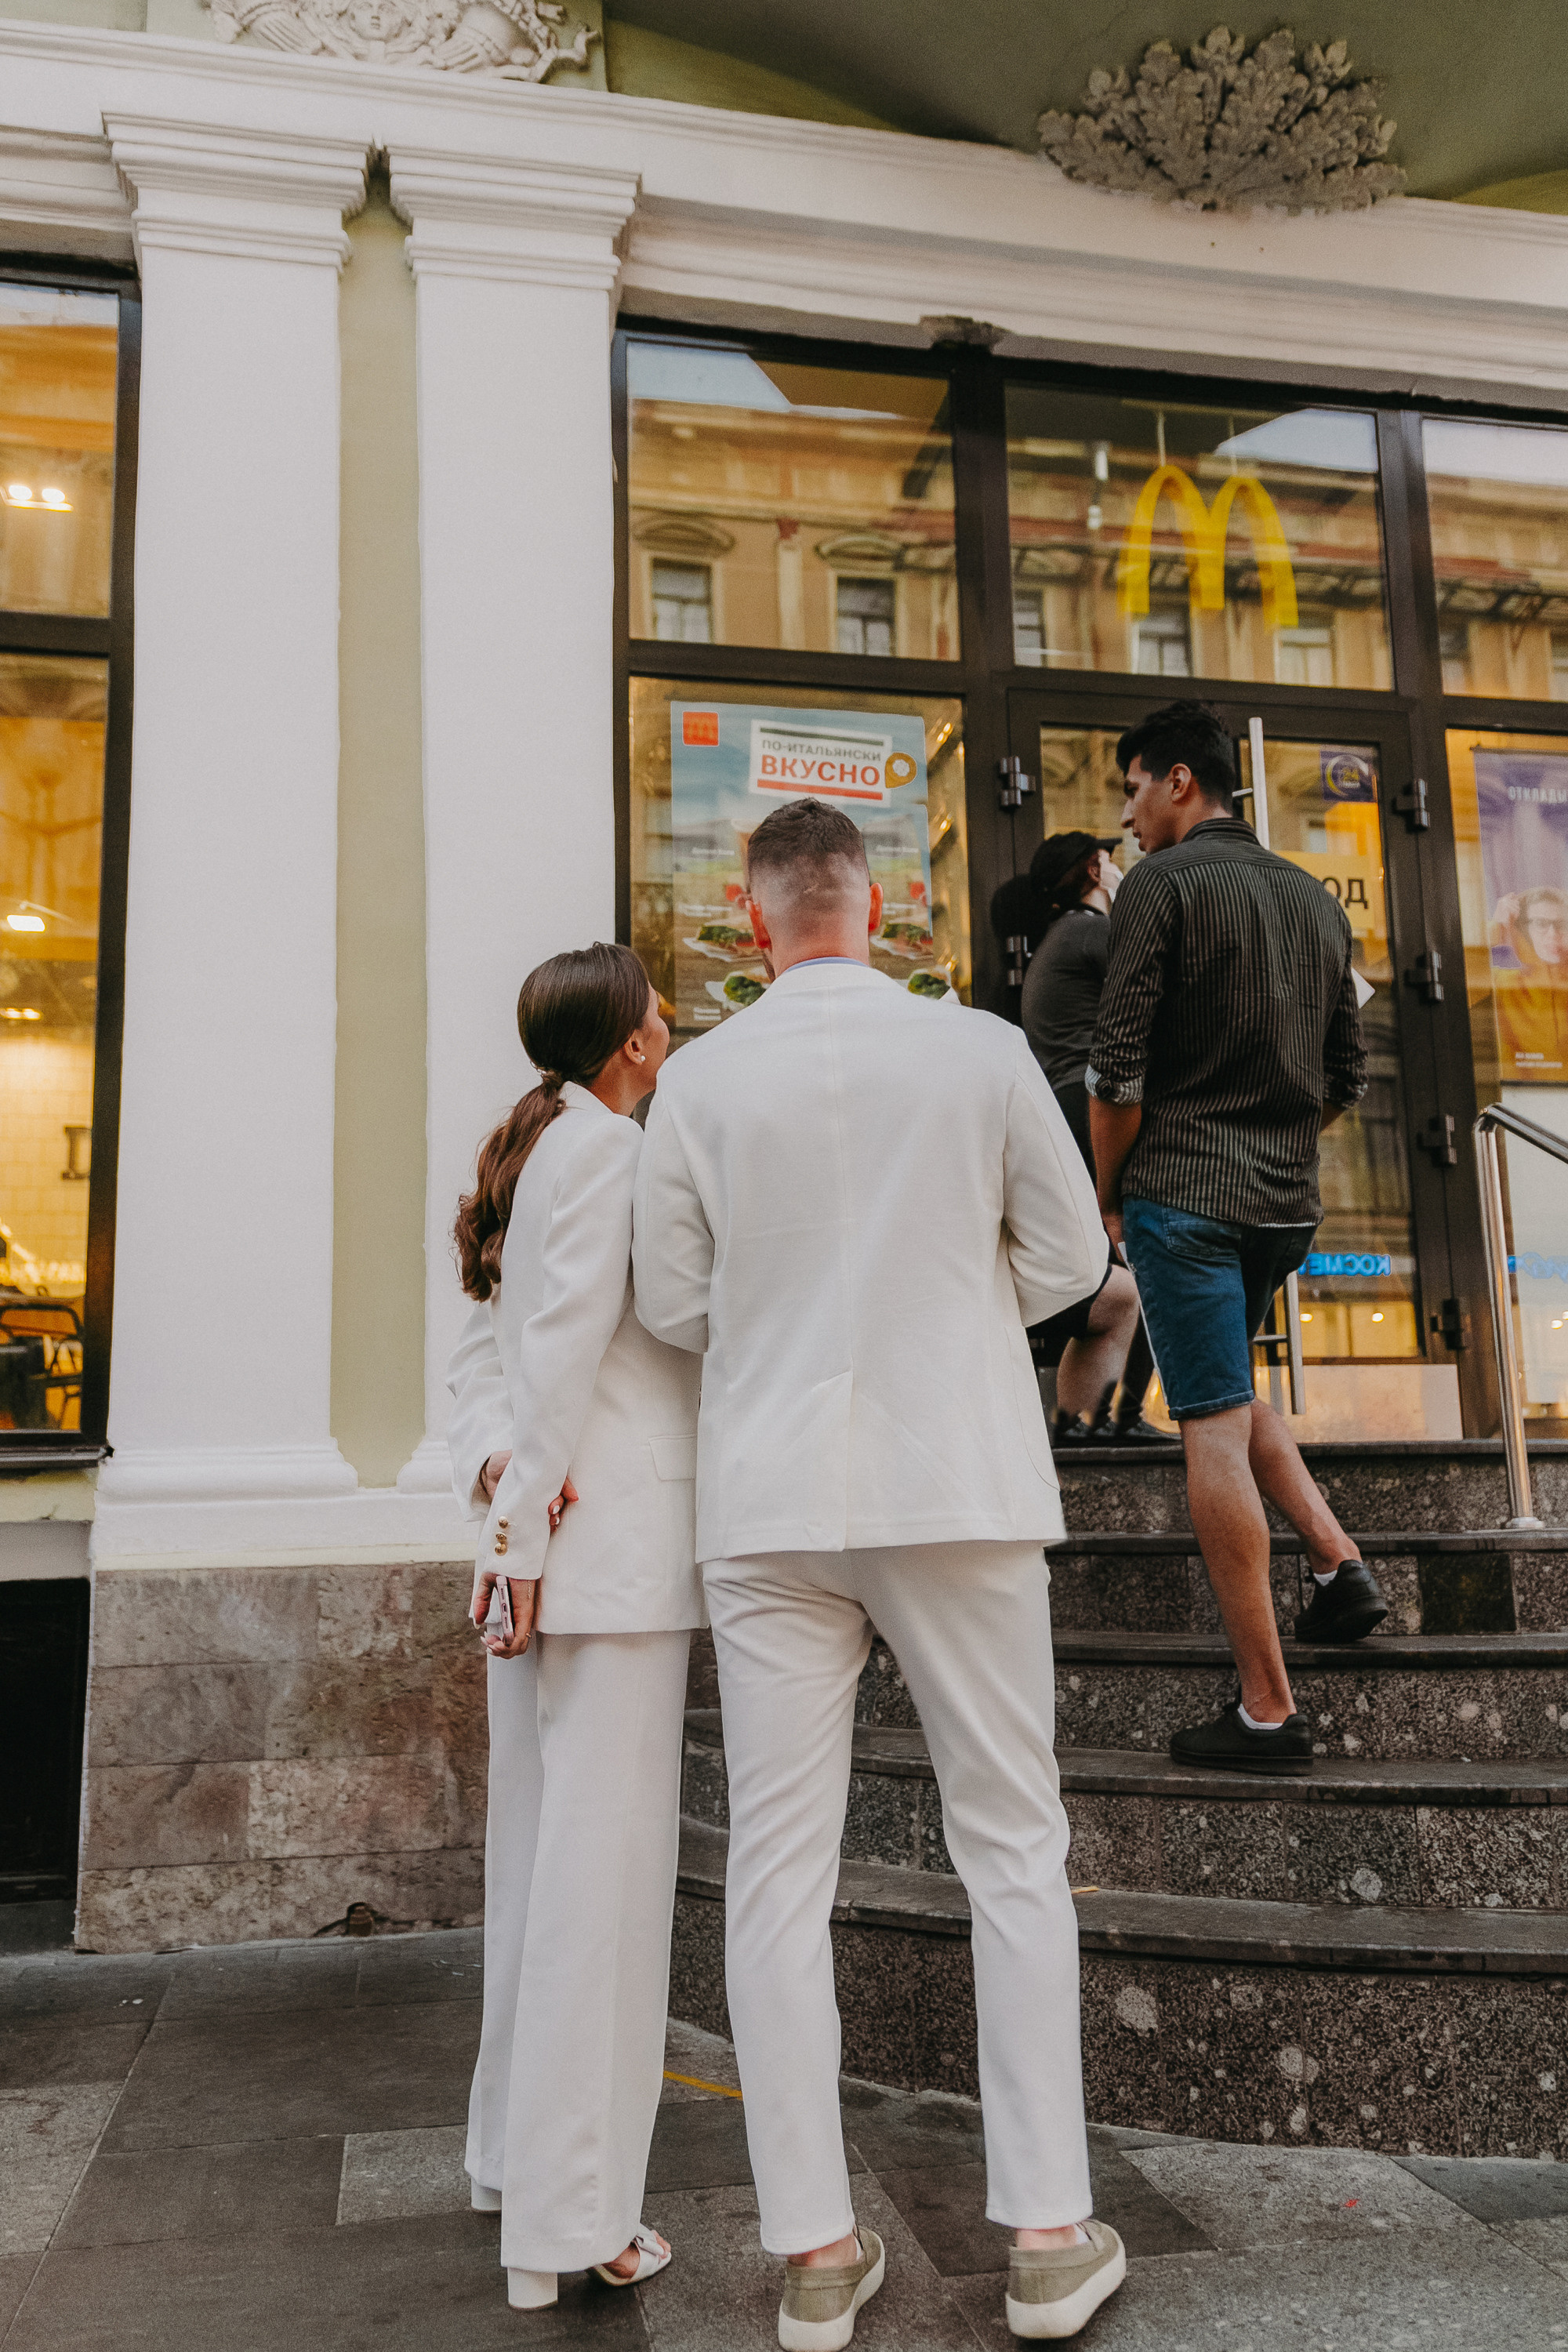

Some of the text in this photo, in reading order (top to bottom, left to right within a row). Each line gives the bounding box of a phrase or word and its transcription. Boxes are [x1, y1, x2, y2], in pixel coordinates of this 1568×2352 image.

[1116, 464, 1298, 630] M
[762, 739, 881, 761] ПО-ИТАЛЬЯНСКИ
[761, 754, 880, 786] ВКУСНО
[1322, 877, 1368, 909] ОД
